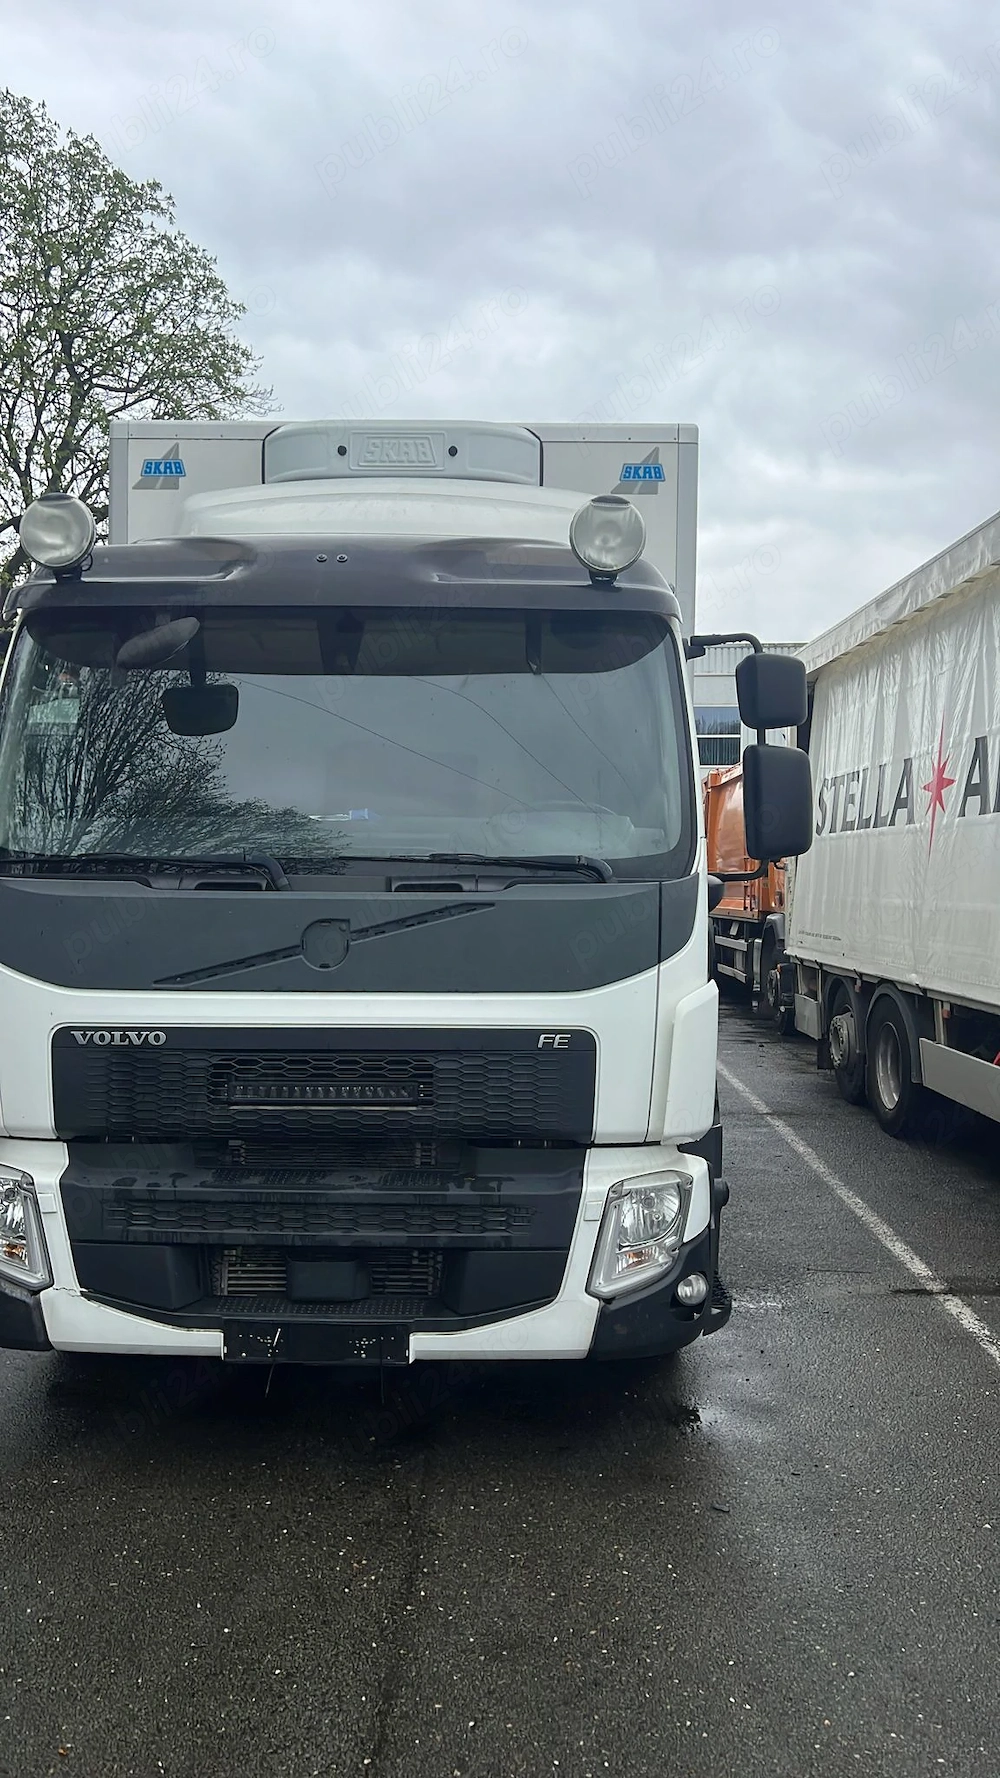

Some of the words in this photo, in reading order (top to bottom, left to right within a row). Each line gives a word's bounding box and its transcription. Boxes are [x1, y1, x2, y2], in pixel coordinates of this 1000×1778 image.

[363, 440, 433, 463] SKAB
[143, 461, 183, 475] SKAB
[623, 466, 663, 479] SKAB
[816, 757, 916, 836] STELLA
[957, 736, 1000, 817] A
[70, 1031, 167, 1046] VOLVO
[537, 1034, 571, 1048] FE
